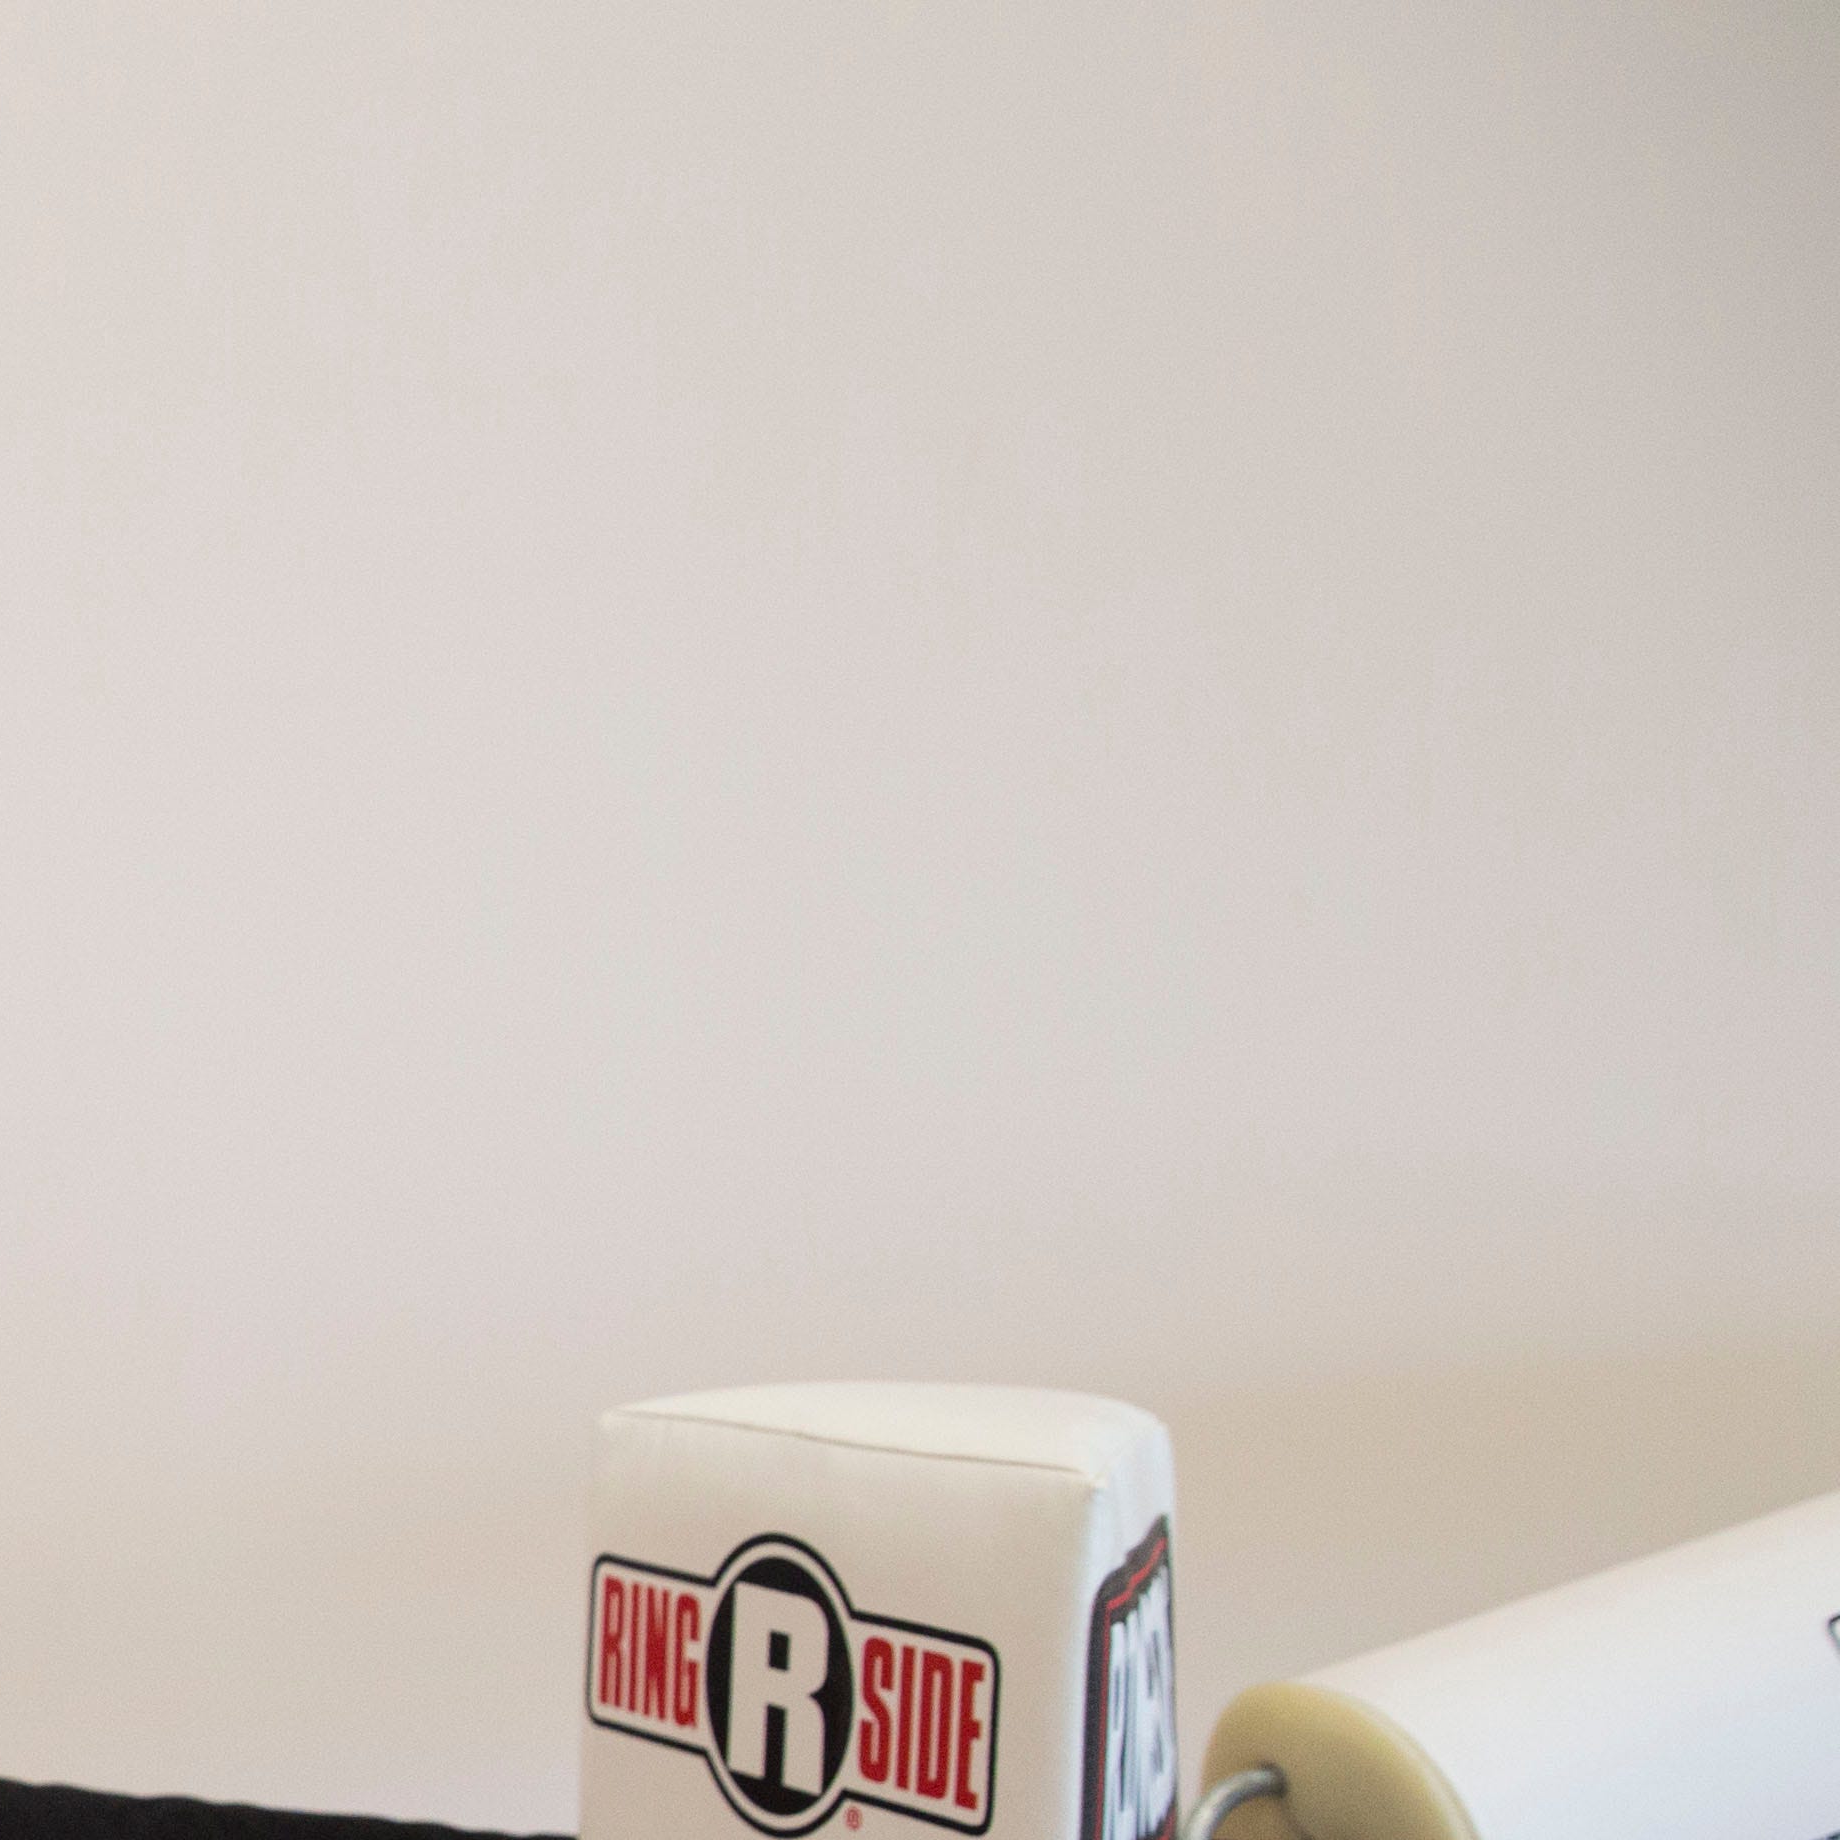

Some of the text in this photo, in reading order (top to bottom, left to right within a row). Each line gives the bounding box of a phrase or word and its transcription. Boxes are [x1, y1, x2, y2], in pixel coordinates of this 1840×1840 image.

[599, 1574, 986, 1812] RING R SIDE
